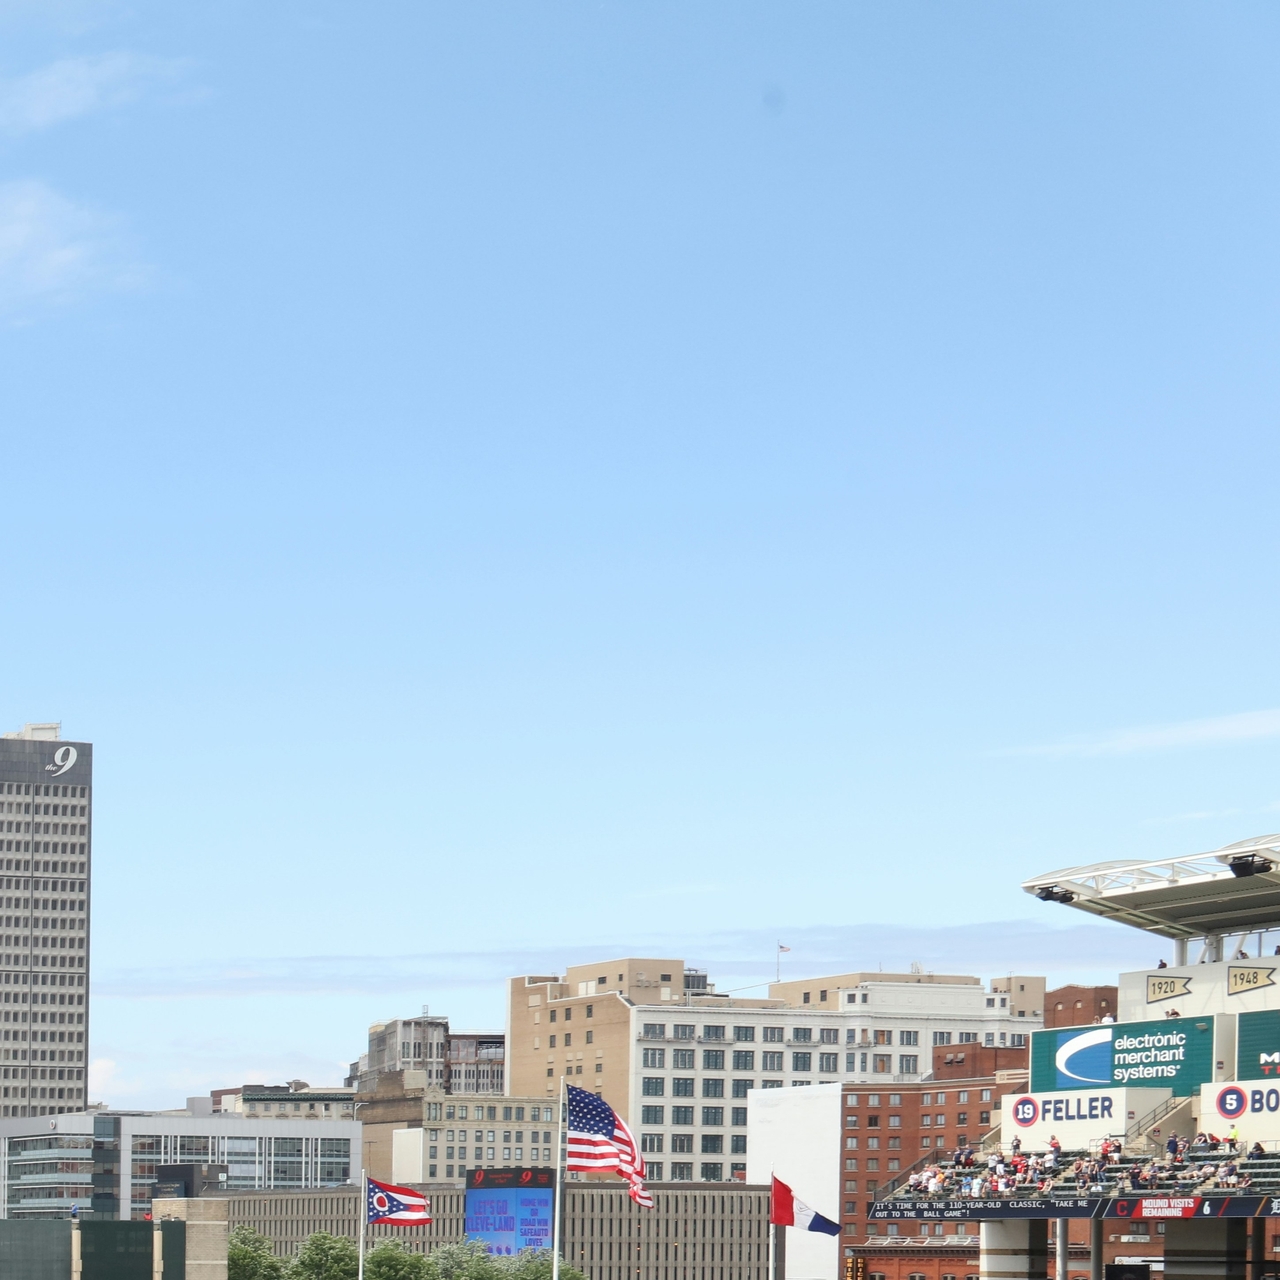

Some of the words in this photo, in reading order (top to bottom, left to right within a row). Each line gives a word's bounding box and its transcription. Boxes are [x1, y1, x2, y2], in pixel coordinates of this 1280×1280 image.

[51, 746, 78, 777] 9
[1233, 971, 1258, 986] 1948
[1152, 980, 1176, 995] 1920
[1114, 1031, 1186, 1050] electronic
[1114, 1047, 1185, 1064] merchant
[1114, 1065, 1176, 1083] systems
[1017, 1104, 1034, 1120] 19
[1041, 1096, 1113, 1121] FELLER
[1225, 1095, 1237, 1110] 5
[949, 1201, 1001, 1209] 110-YEAR-OLD
[1009, 1201, 1045, 1209] CLASSIC,
[1142, 1200, 1167, 1208] MOUND
[1169, 1199, 1194, 1208] VISITS
[1202, 1202, 1210, 1215] 6
[1142, 1208, 1182, 1217] REMAINING
